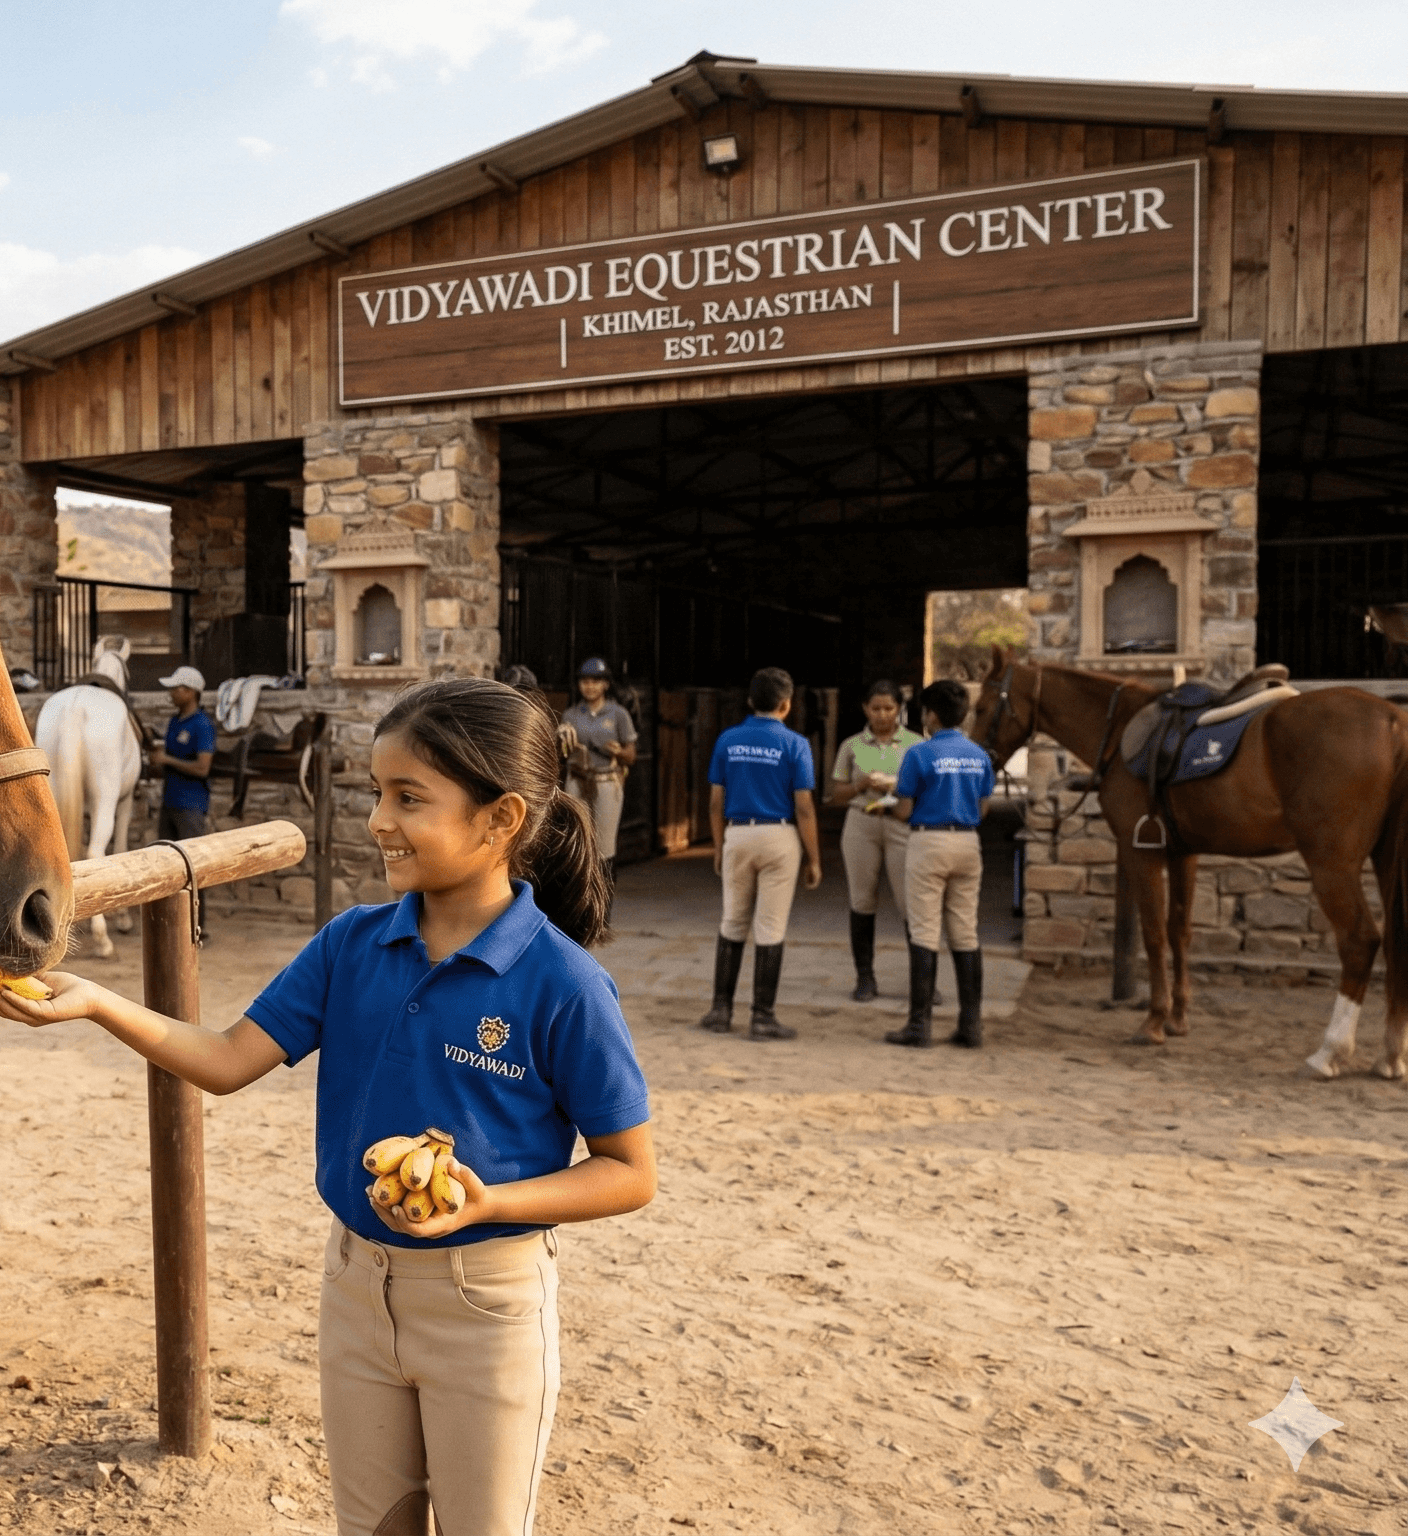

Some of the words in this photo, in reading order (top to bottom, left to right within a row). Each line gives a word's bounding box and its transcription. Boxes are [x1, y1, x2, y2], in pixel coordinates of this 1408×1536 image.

[355, 262, 593, 328] VIDYAWADI
[604, 218, 926, 301] EQUESTRIAN
[939, 187, 1173, 257] CENTER
[582, 306, 696, 337] KHIMEL,
[702, 283, 873, 325] RAJASTHAN
[664, 334, 718, 361] EST.
[725, 326, 784, 354] 2012
[444, 1043, 526, 1080] VIDYAWADI
